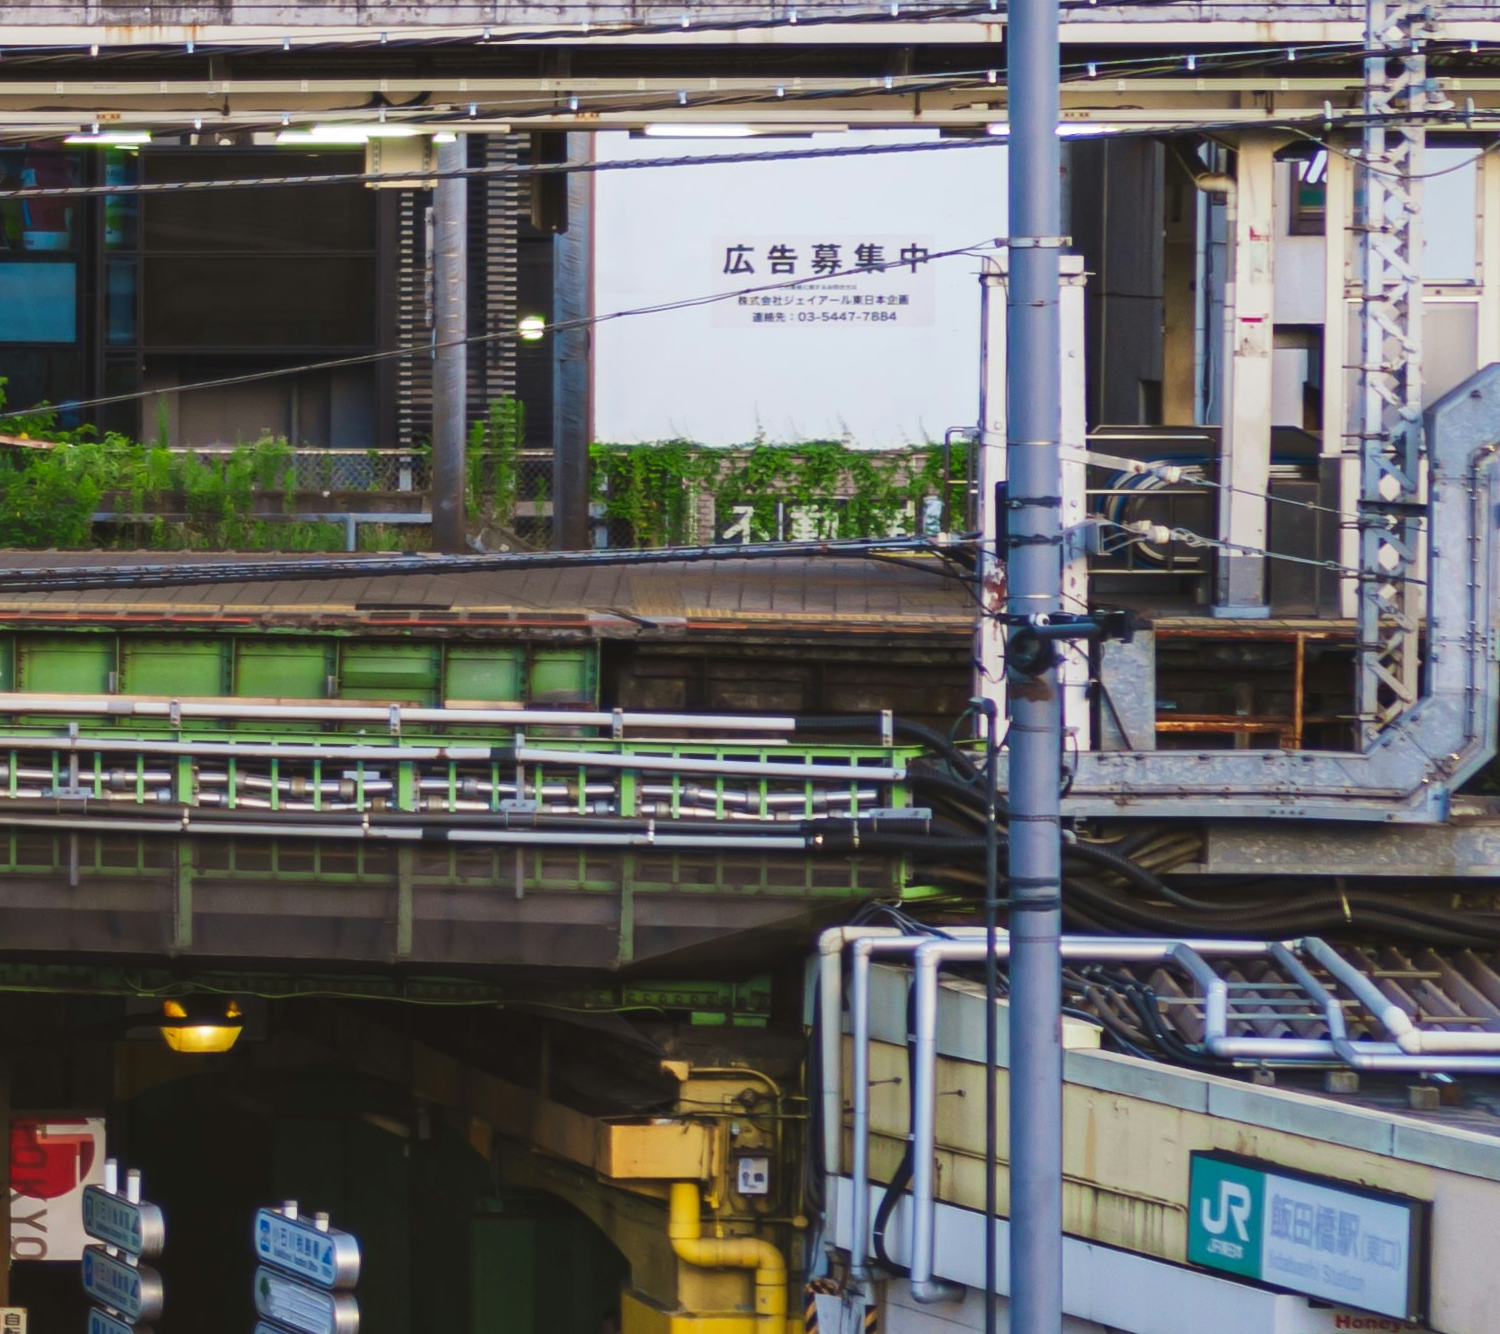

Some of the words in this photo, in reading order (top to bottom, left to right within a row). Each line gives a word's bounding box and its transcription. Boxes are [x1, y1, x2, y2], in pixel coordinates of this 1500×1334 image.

[722, 243, 929, 275] 広告募集中
[737, 294, 910, 306] 株式会社ジェイアール東日本企画
[1201, 1179, 1250, 1242] JR
[1270, 1192, 1361, 1259] 飯田橋駅
